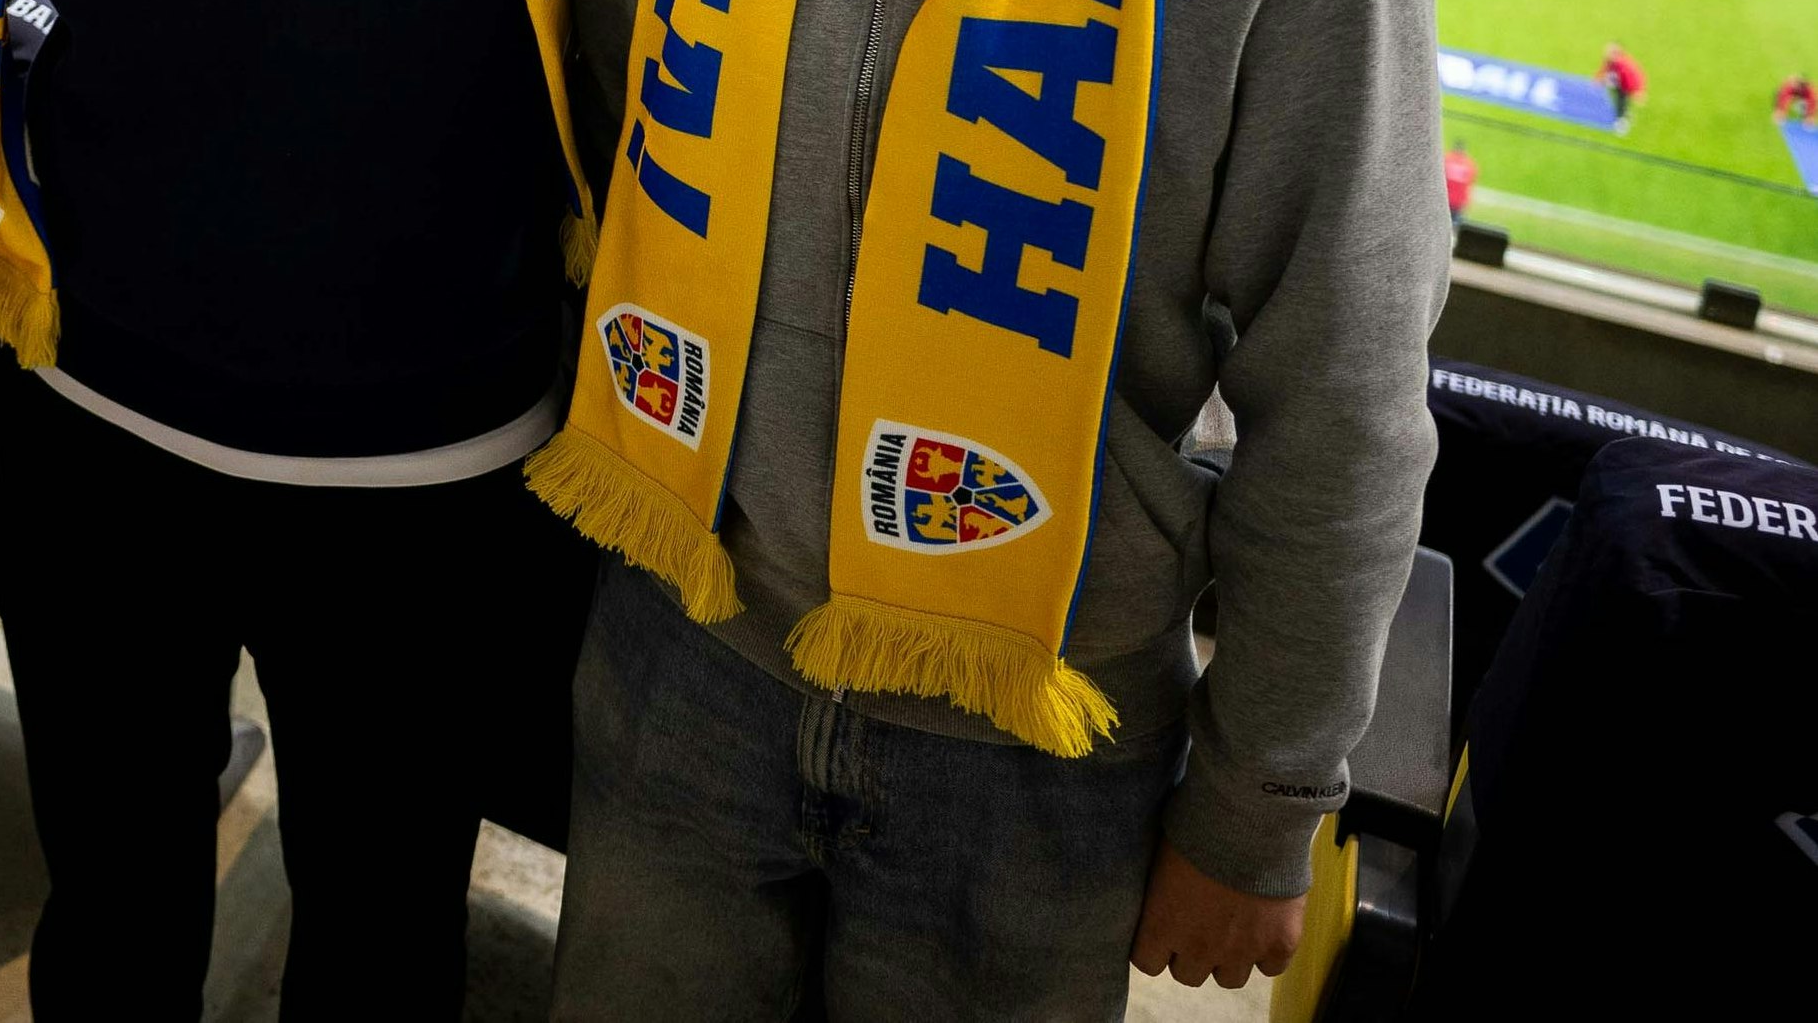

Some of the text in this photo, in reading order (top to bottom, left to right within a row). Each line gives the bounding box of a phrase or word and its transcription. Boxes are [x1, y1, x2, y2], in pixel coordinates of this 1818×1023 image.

[677, 339, 706, 438] ROMÂNIA
[866, 433, 907, 538] ROMÂNIA
[1656, 484, 1818, 542] FEDER
[1262, 782, 1317, 799] CALVIN
